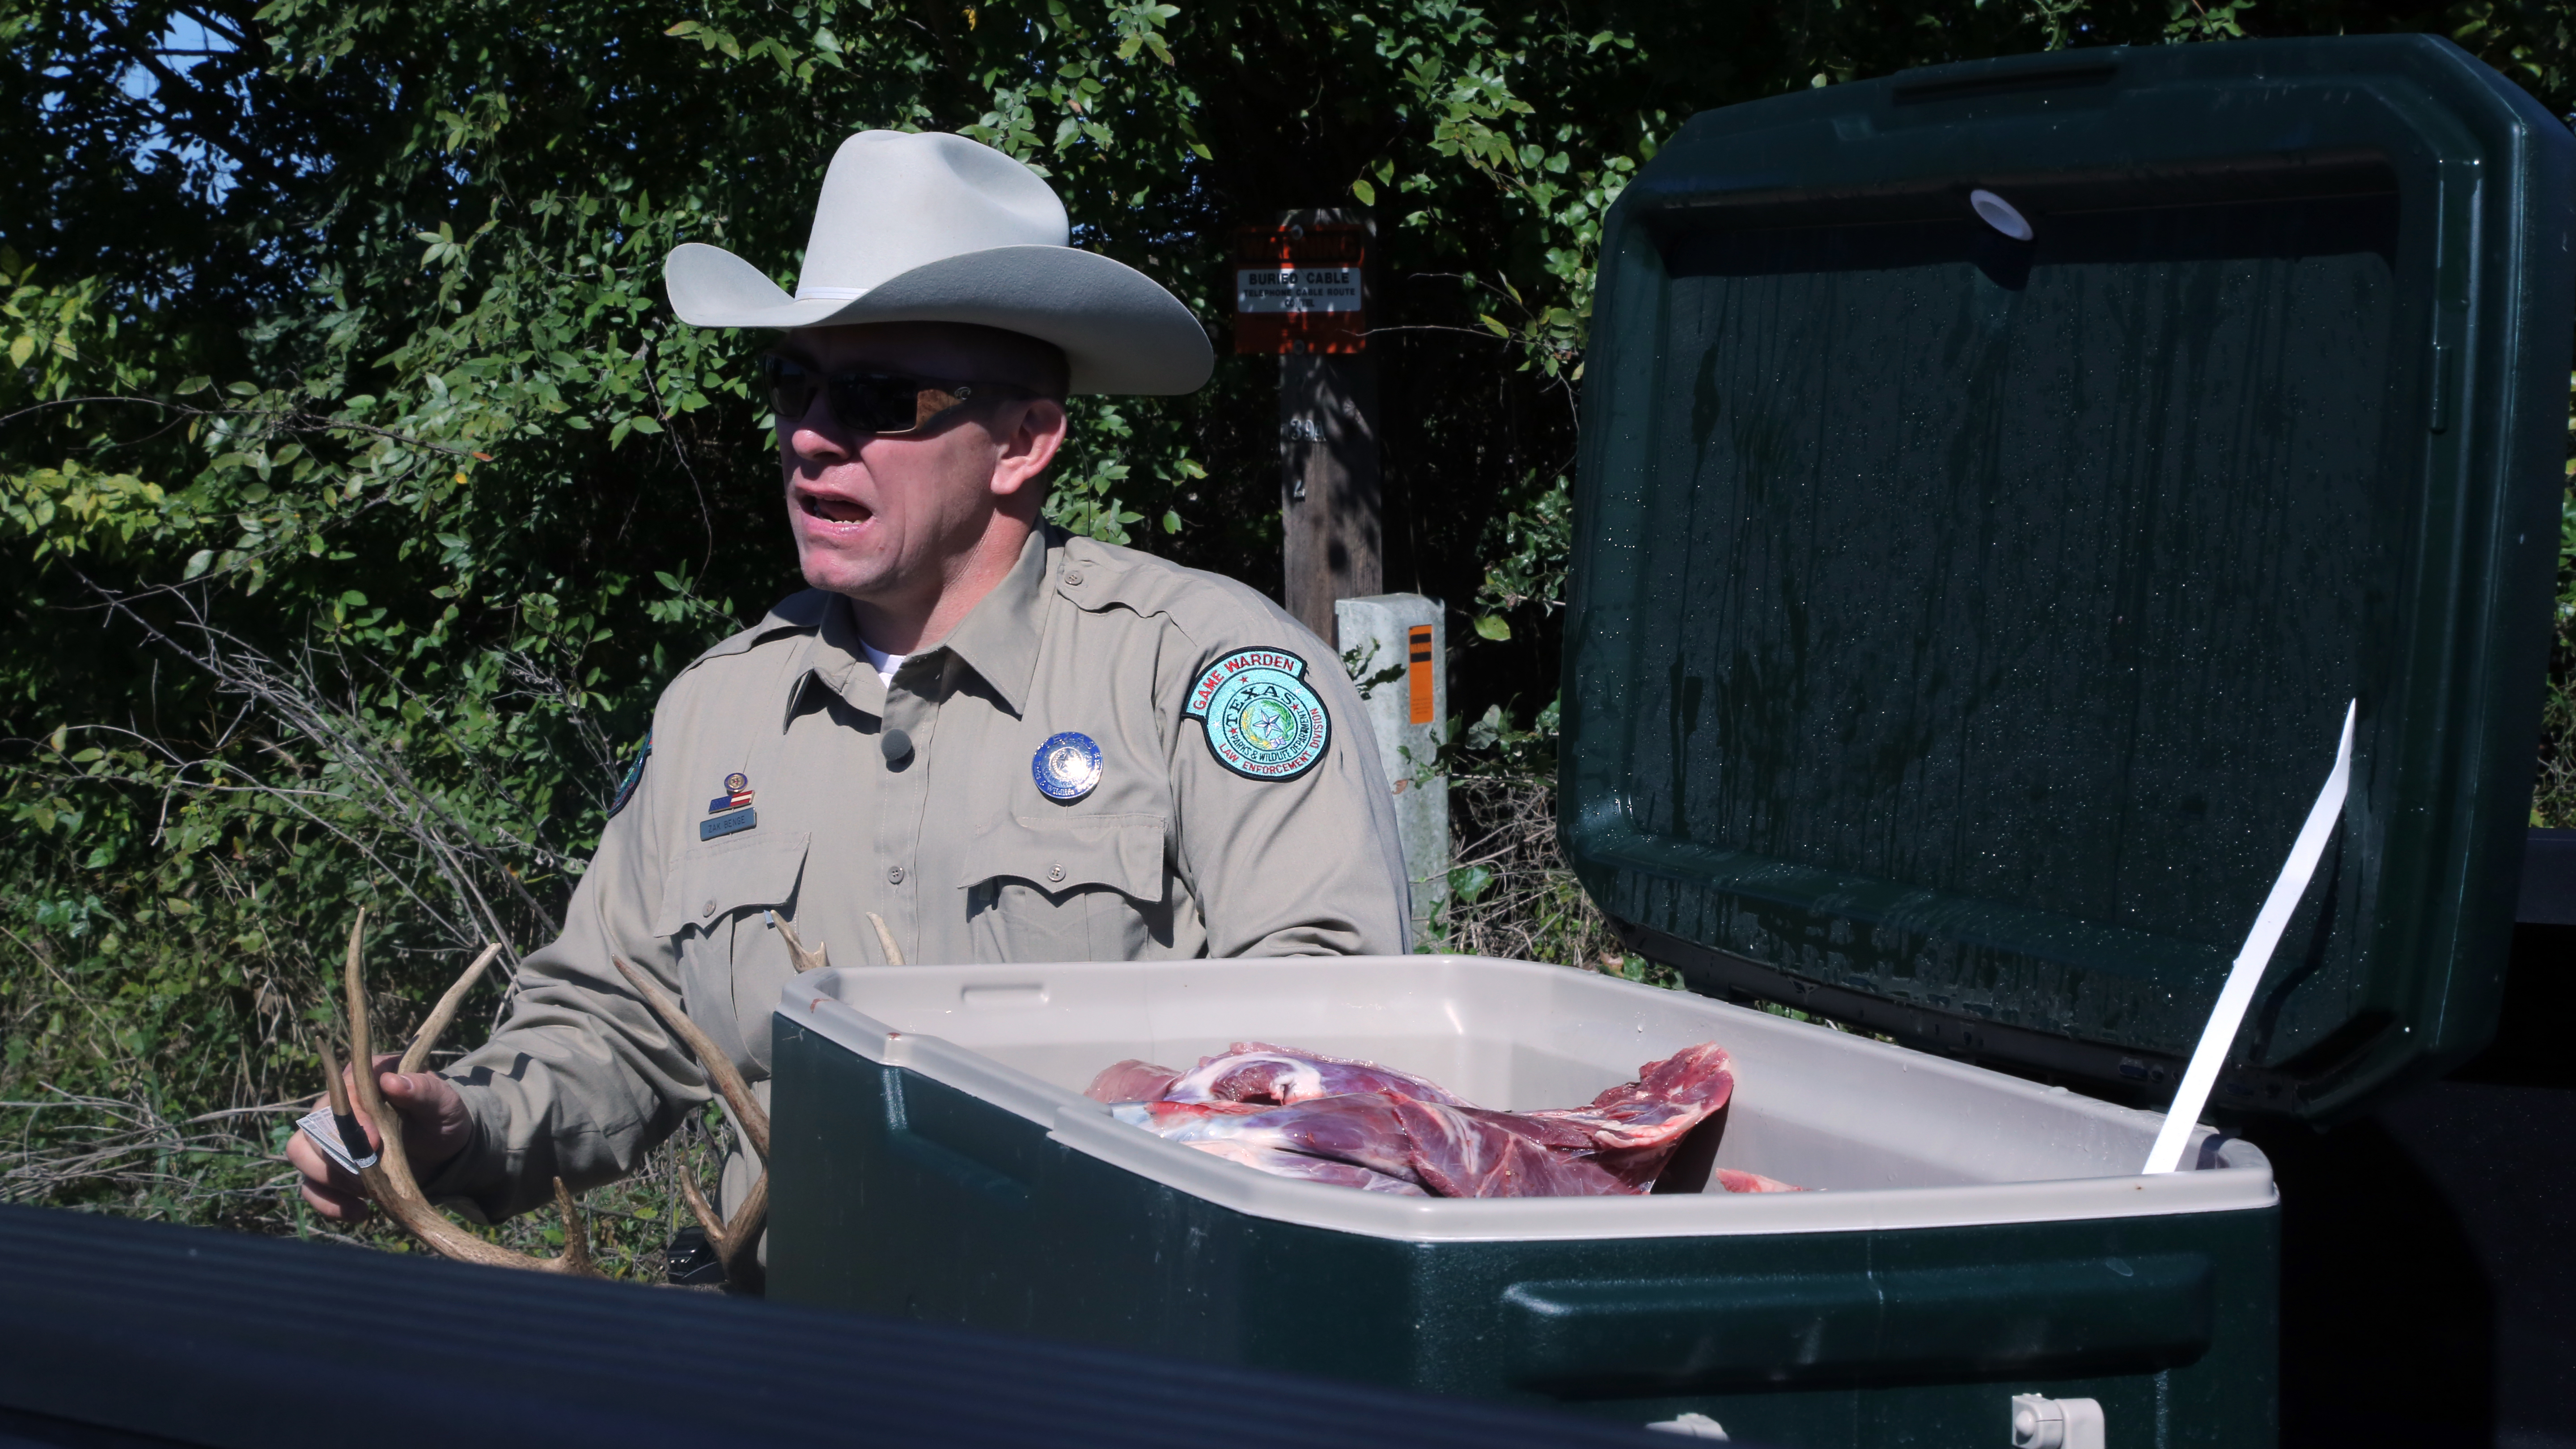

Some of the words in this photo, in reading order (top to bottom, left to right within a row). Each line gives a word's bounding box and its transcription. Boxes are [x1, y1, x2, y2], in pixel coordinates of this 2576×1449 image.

[1244, 289, 1292, 297] TELEPHONE
[1297, 288, 1323, 297] CABLE
[1327, 288, 1356, 296] ROUTE
[1249, 273, 1298, 285] BURIED
[1307, 272, 1350, 284] CABLE
[1193, 670, 1224, 710] GAME
[1224, 654, 1294, 672] WARDEN
[1226, 686, 1296, 726] TEXAS
[1219, 743, 1239, 763] LAW
[1242, 750, 1313, 774] ENFORCEMENT
[1309, 708, 1323, 749] DIVISION
[1231, 734, 1250, 755] PARKS
[1259, 749, 1292, 761] WILDLIFE
[1290, 710, 1309, 754] DEPARTMENT
[708, 823, 721, 833] ZAK
[724, 816, 745, 828] BENGE
